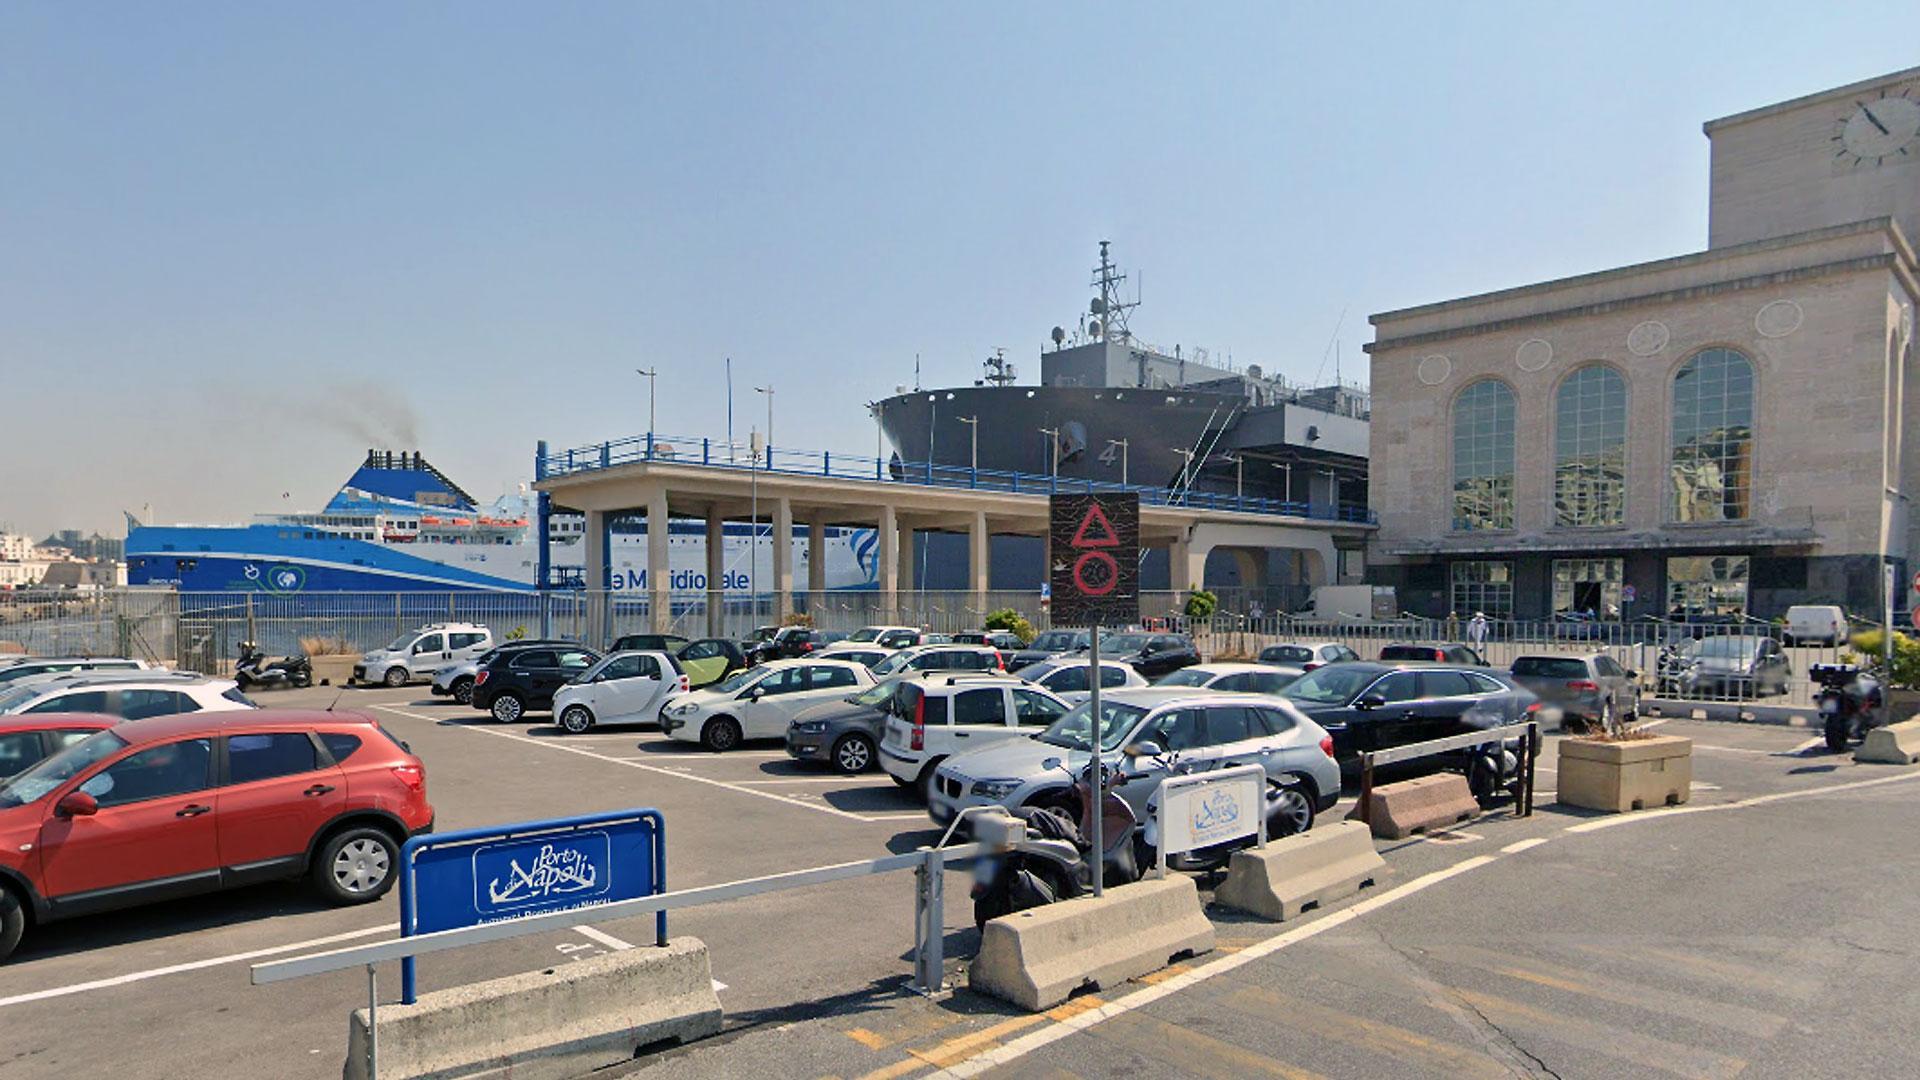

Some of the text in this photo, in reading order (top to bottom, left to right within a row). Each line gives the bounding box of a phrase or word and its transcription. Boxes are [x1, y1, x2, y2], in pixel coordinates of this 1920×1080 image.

[1098, 444, 1116, 466] 4
[540, 844, 579, 867] Porto
[511, 853, 590, 896] Napoli
